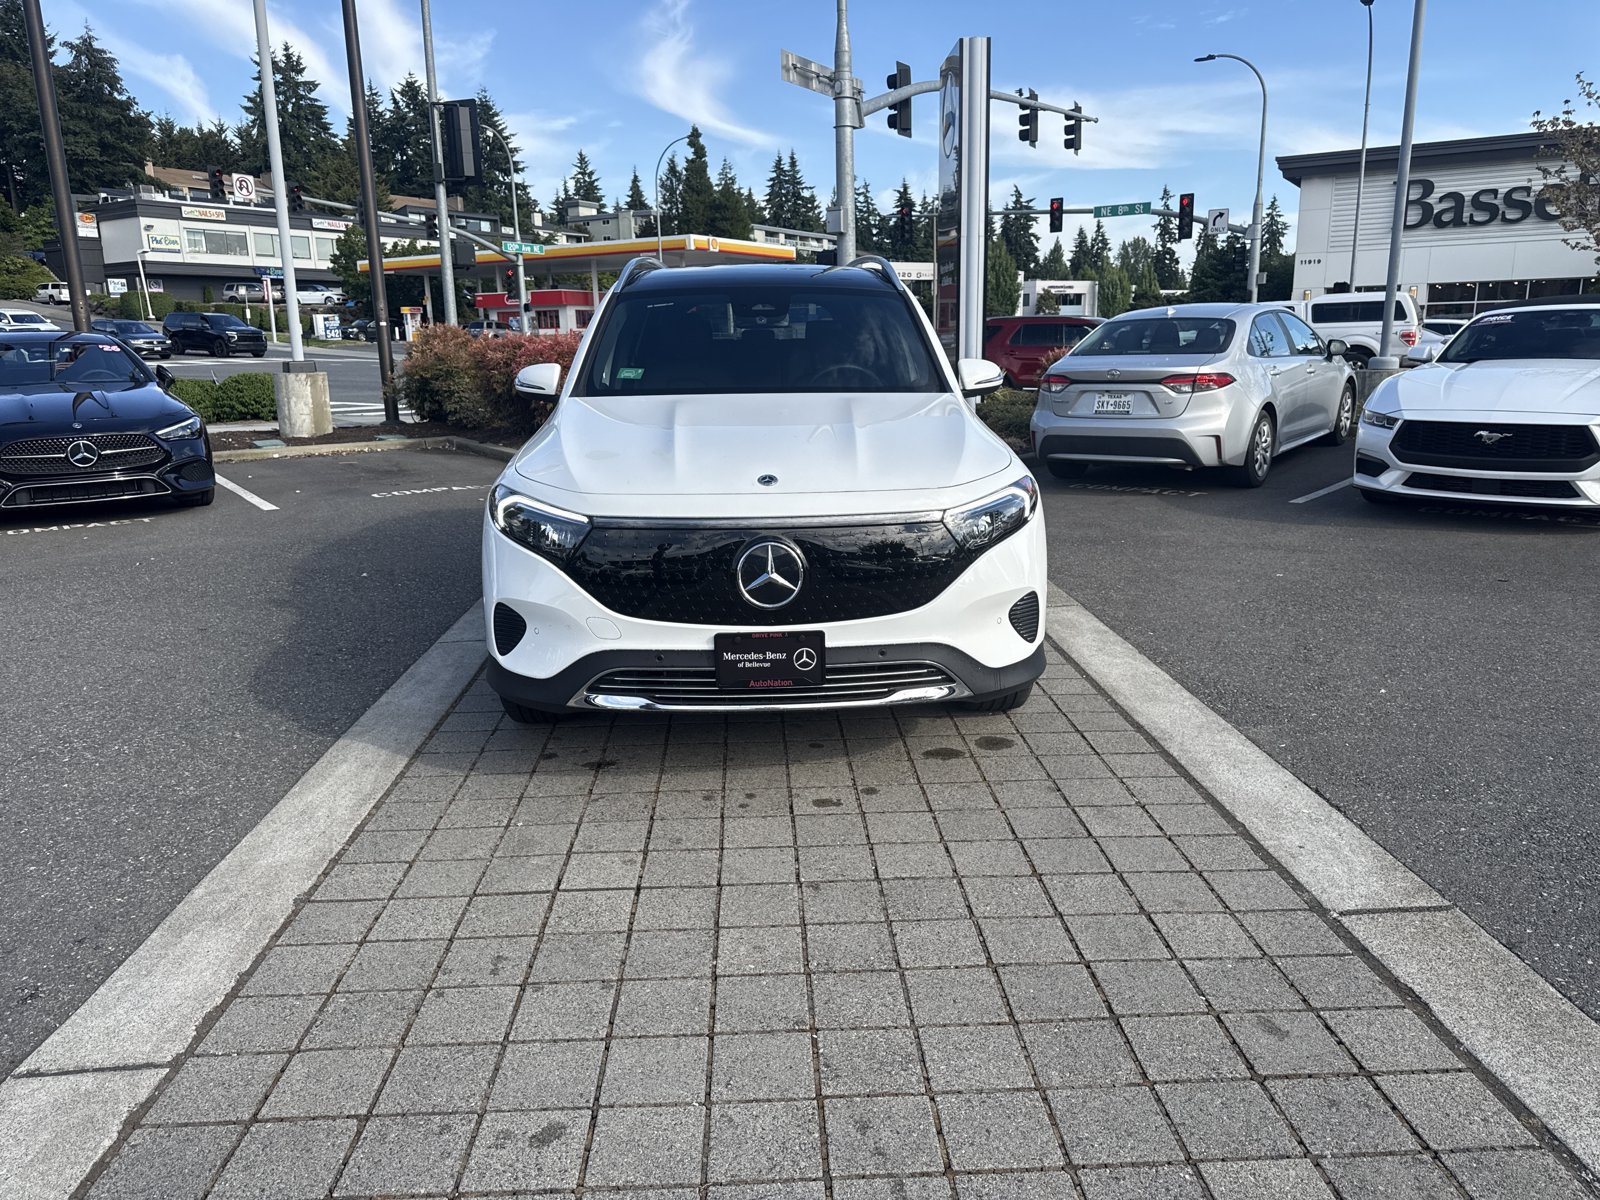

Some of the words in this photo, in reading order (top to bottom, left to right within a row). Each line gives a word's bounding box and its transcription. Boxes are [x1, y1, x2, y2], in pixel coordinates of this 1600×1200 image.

[1100, 207, 1112, 216] NE
[1117, 206, 1129, 215] 8th
[1134, 204, 1144, 214] St
[0, 517, 156, 536] OMPACT
[723, 651, 787, 661] Mercedes-Benz
[749, 679, 793, 688] AutoNation
